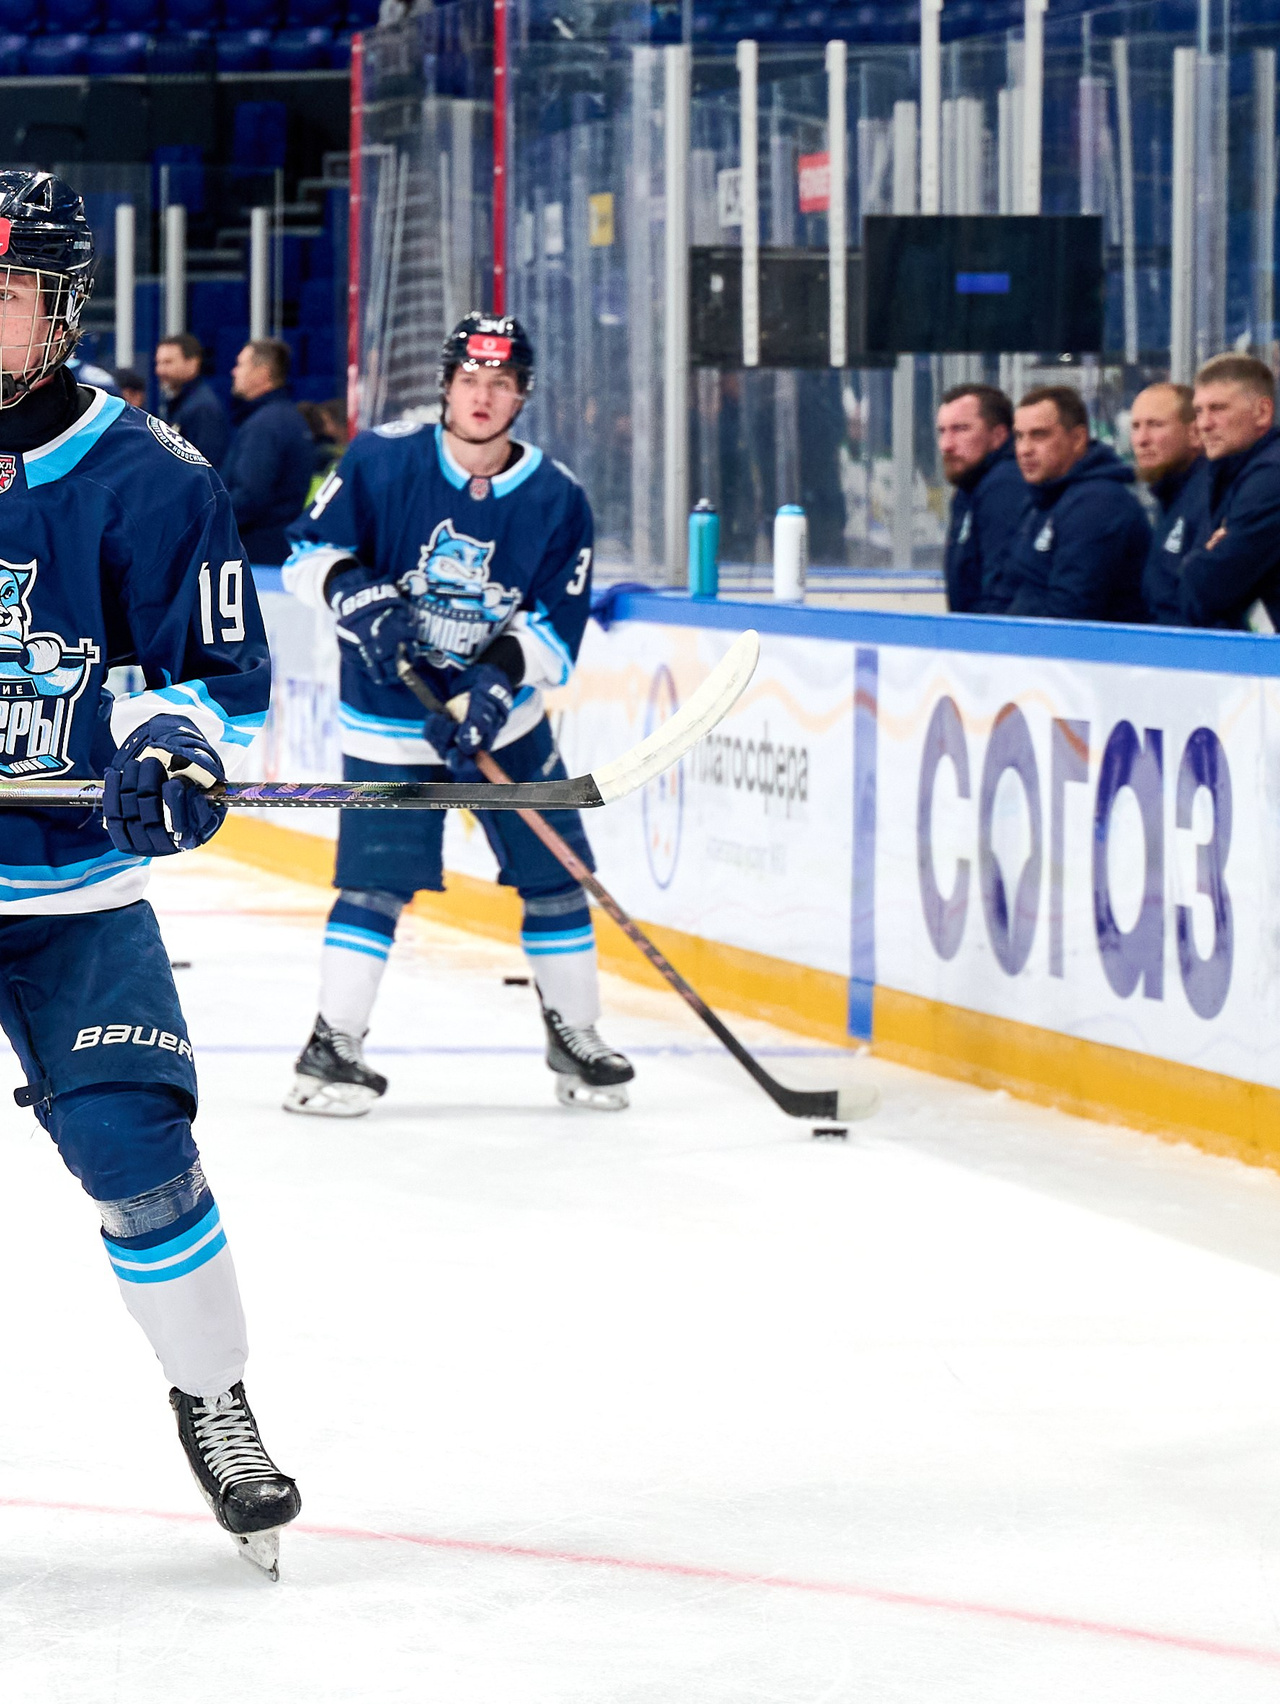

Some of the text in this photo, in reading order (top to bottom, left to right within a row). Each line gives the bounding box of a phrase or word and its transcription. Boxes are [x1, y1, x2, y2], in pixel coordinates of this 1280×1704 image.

[309, 469, 343, 520] 4
[566, 548, 592, 595] 3
[198, 559, 245, 645] 19
